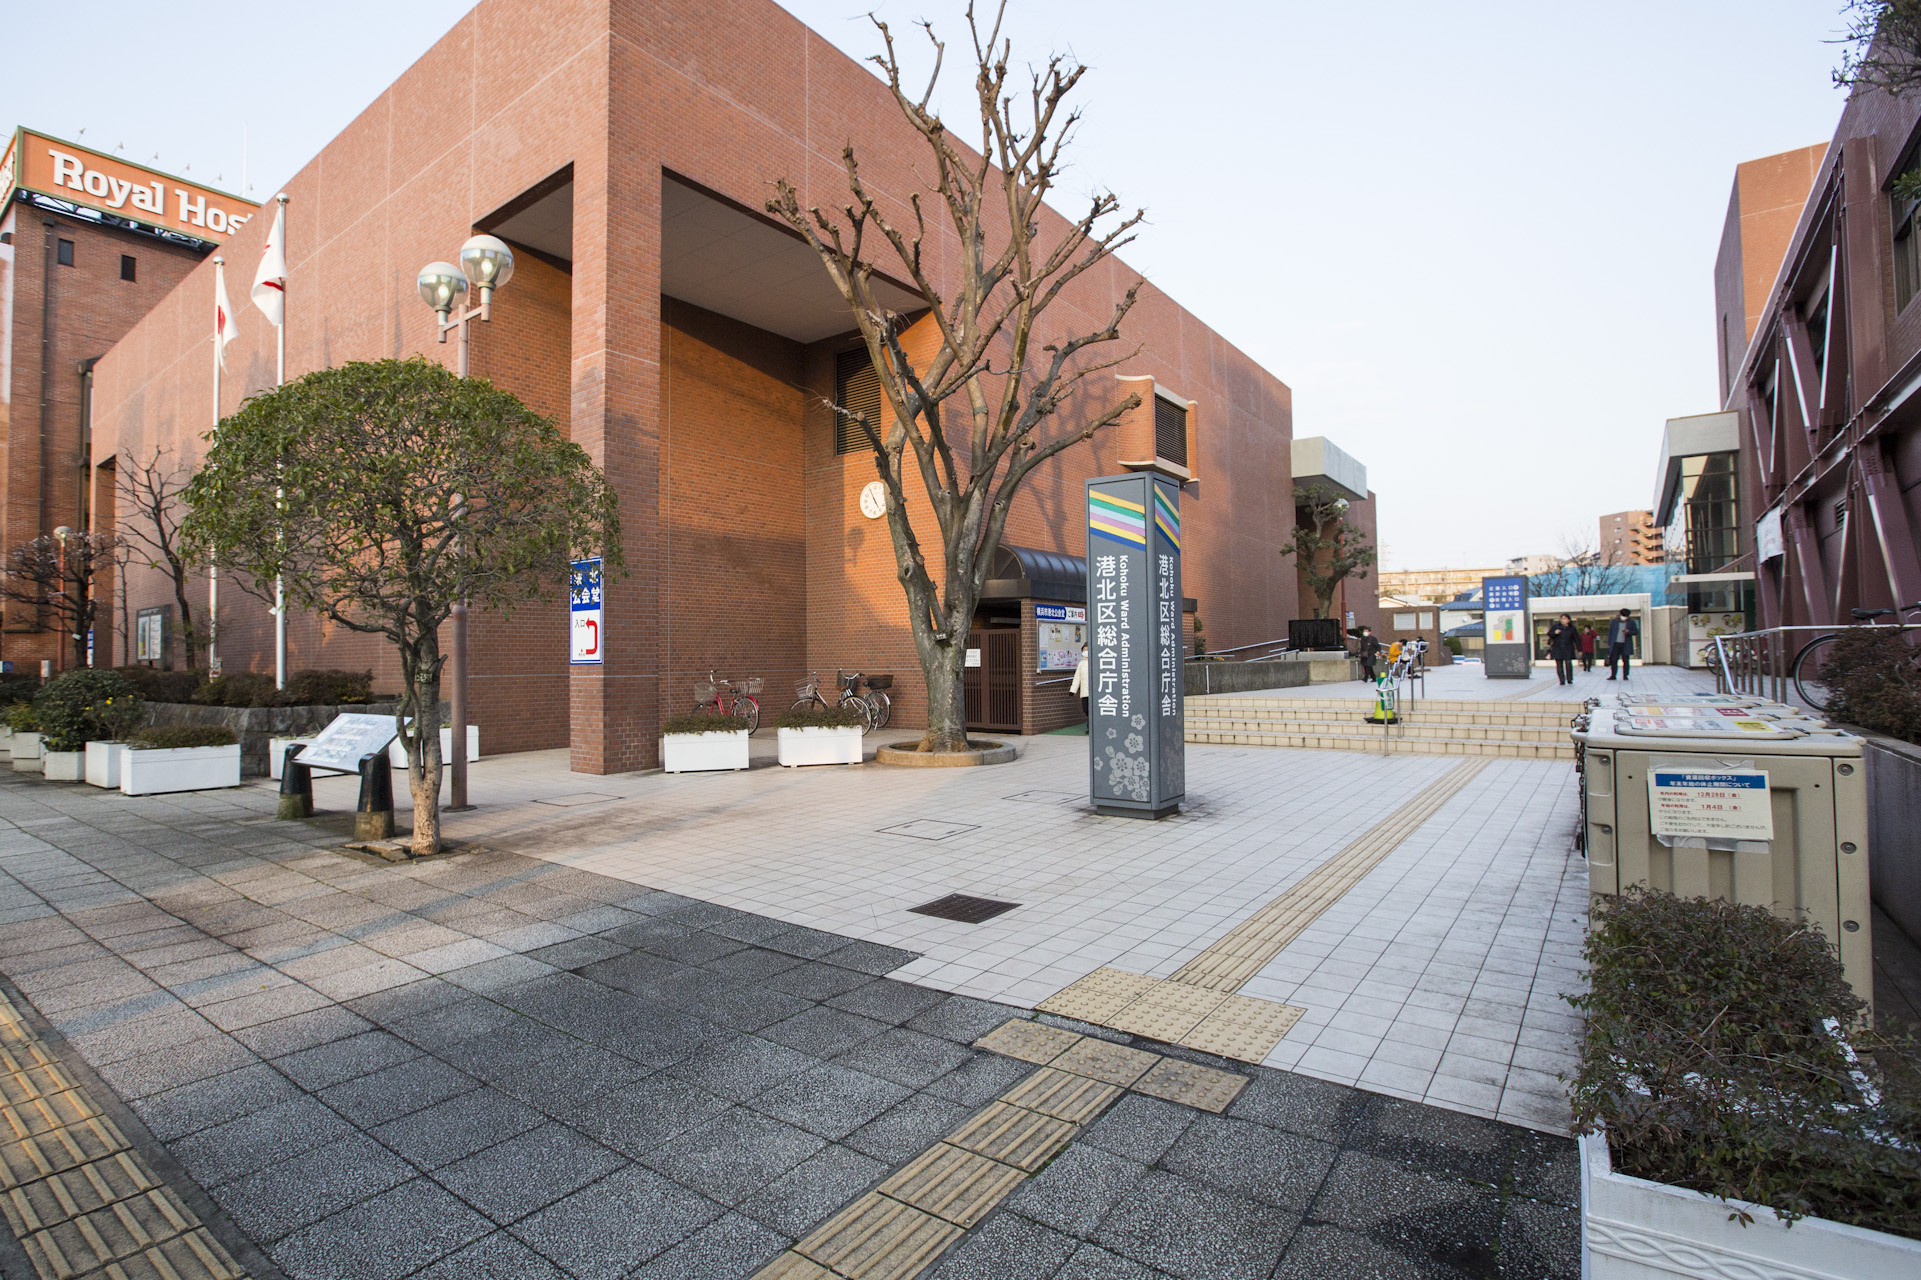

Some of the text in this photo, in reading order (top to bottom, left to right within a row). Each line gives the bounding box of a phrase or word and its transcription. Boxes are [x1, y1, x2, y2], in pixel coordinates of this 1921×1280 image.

[48, 148, 164, 215] Royal
[175, 188, 254, 236] Hos
[575, 620, 585, 628] 入口
[1096, 555, 1118, 717] 港北区総合庁舎
[1119, 555, 1131, 718] Kohoku Ward Administration
[1158, 554, 1172, 717] 港北区総合庁舎
